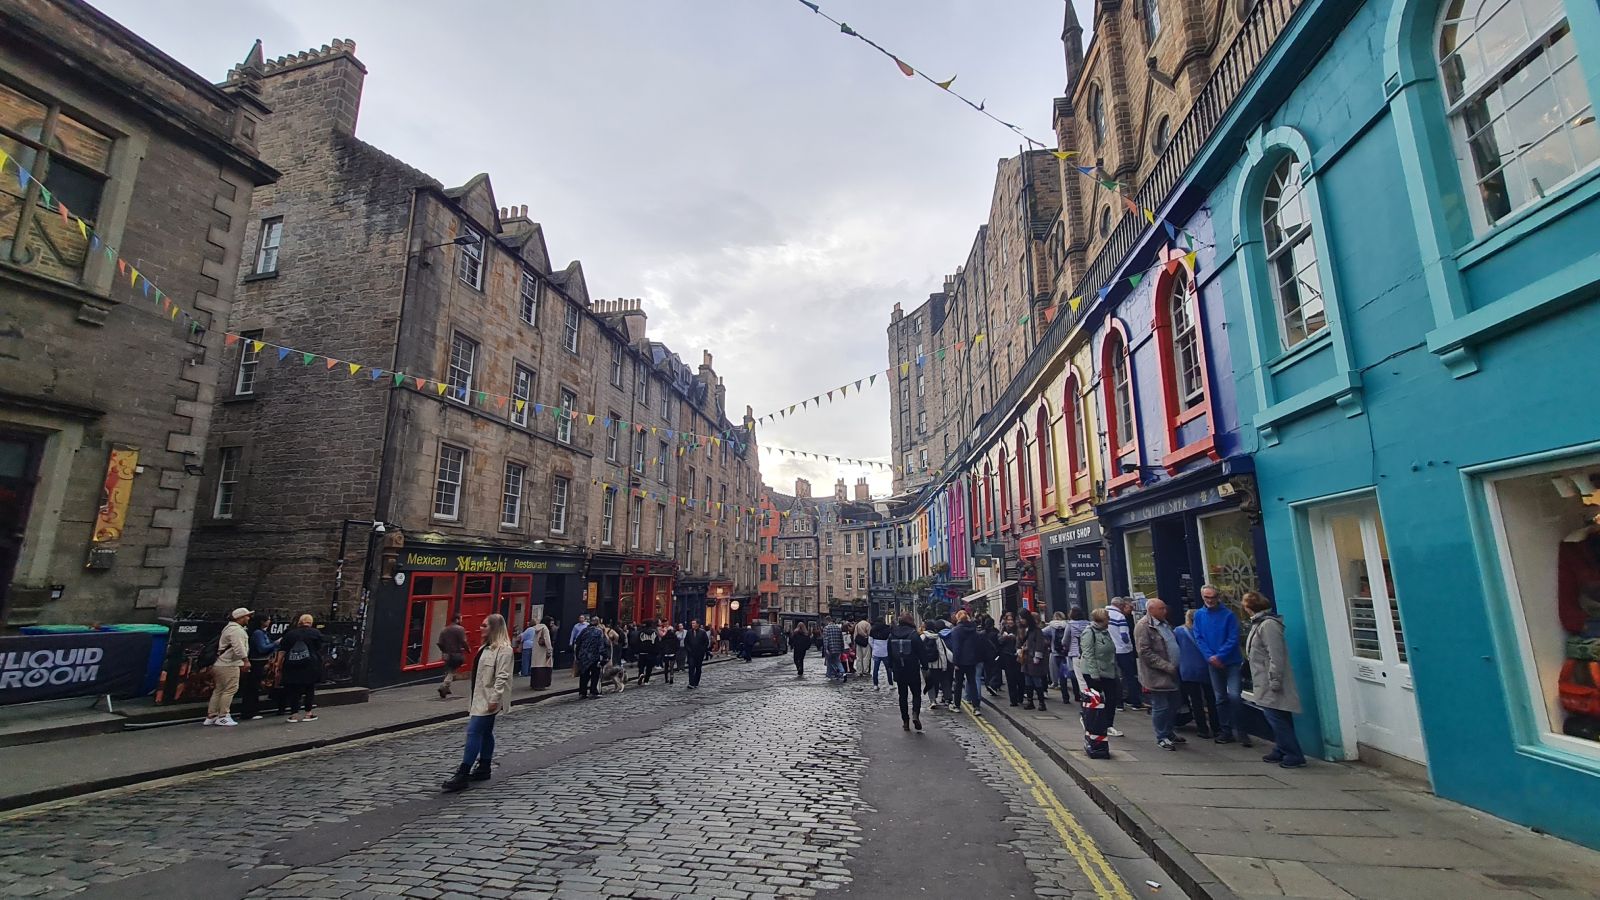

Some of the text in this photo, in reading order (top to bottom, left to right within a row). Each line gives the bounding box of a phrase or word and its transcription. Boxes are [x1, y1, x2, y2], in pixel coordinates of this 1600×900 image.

[1049, 526, 1091, 545] THE WHISKY SHOP
[407, 552, 447, 566] Mexican
[455, 554, 508, 572] Mariachi
[513, 558, 547, 569] Restaurant
[4, 647, 104, 670] LIQUID
[0, 664, 100, 689] ROOM
